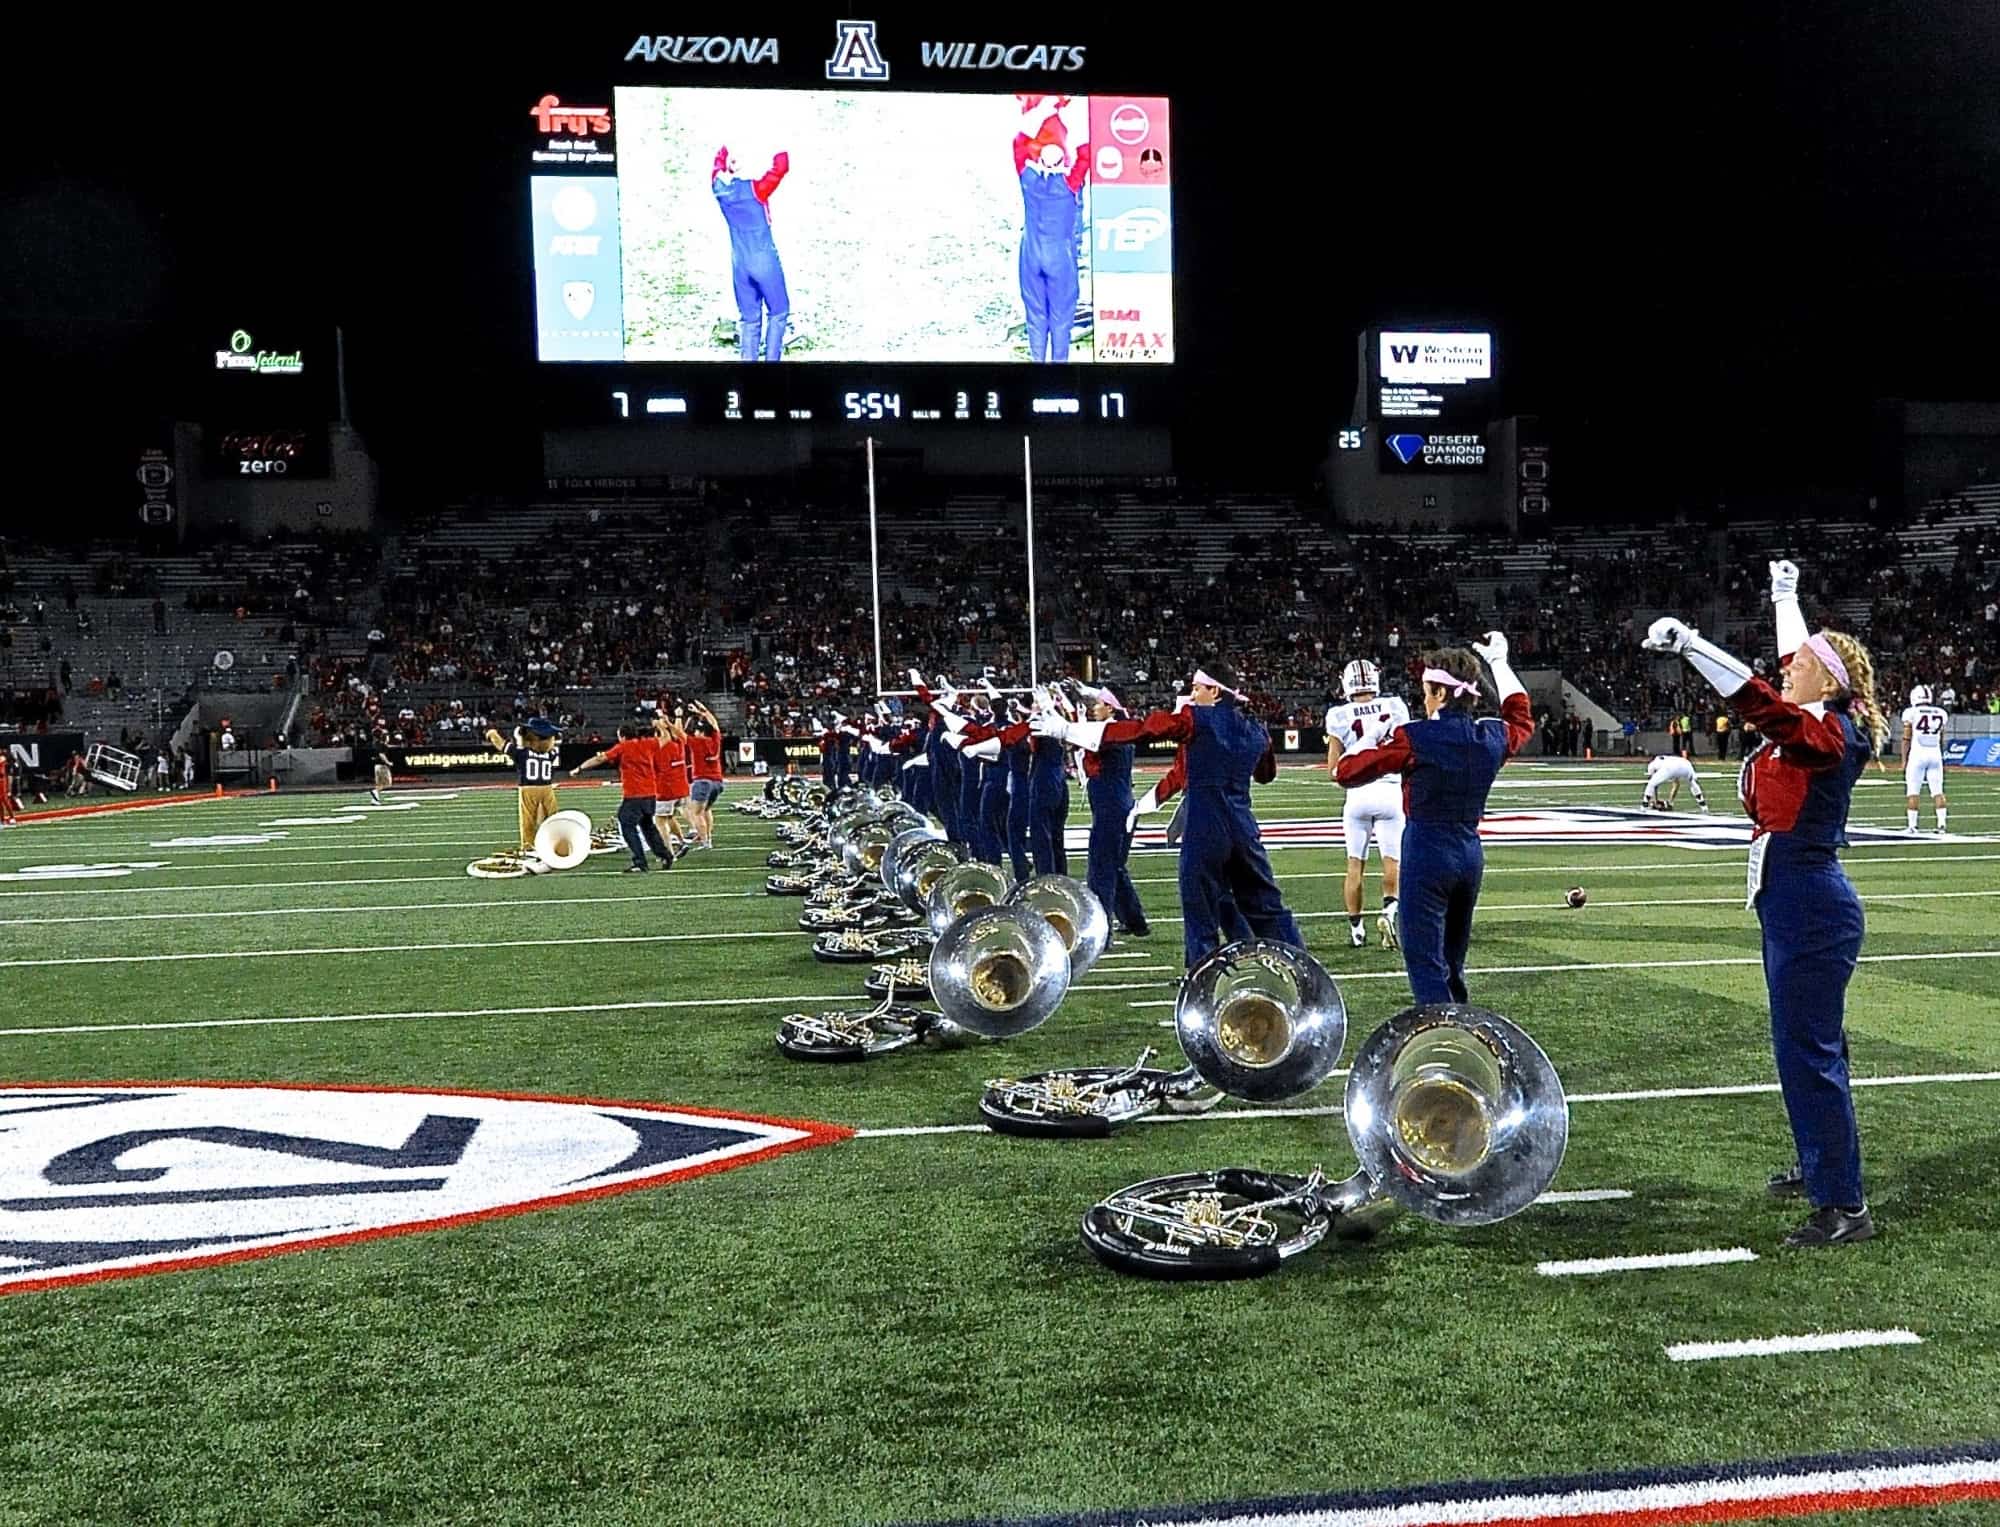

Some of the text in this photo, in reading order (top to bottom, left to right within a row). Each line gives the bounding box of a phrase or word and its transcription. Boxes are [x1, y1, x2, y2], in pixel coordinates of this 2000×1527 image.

[624, 35, 779, 64] ARIZONA
[825, 19, 889, 80] A
[921, 41, 1087, 71] WILDCATS
[1390, 345, 1419, 363] W
[612, 392, 629, 417] 7
[728, 391, 739, 409] 3
[845, 392, 900, 419] 5:54
[957, 391, 968, 409] 3
[988, 391, 998, 409] 3
[1100, 393, 1124, 418] 17
[1338, 431, 1361, 448] 25
[1428, 435, 1479, 445] DESERT
[1423, 445, 1486, 455] DIAMOND
[240, 459, 287, 474] zero
[1424, 455, 1484, 465] CASINOS
[1353, 704, 1382, 717] BAILEY
[1916, 715, 1943, 734] 47
[526, 758, 552, 780] 00
